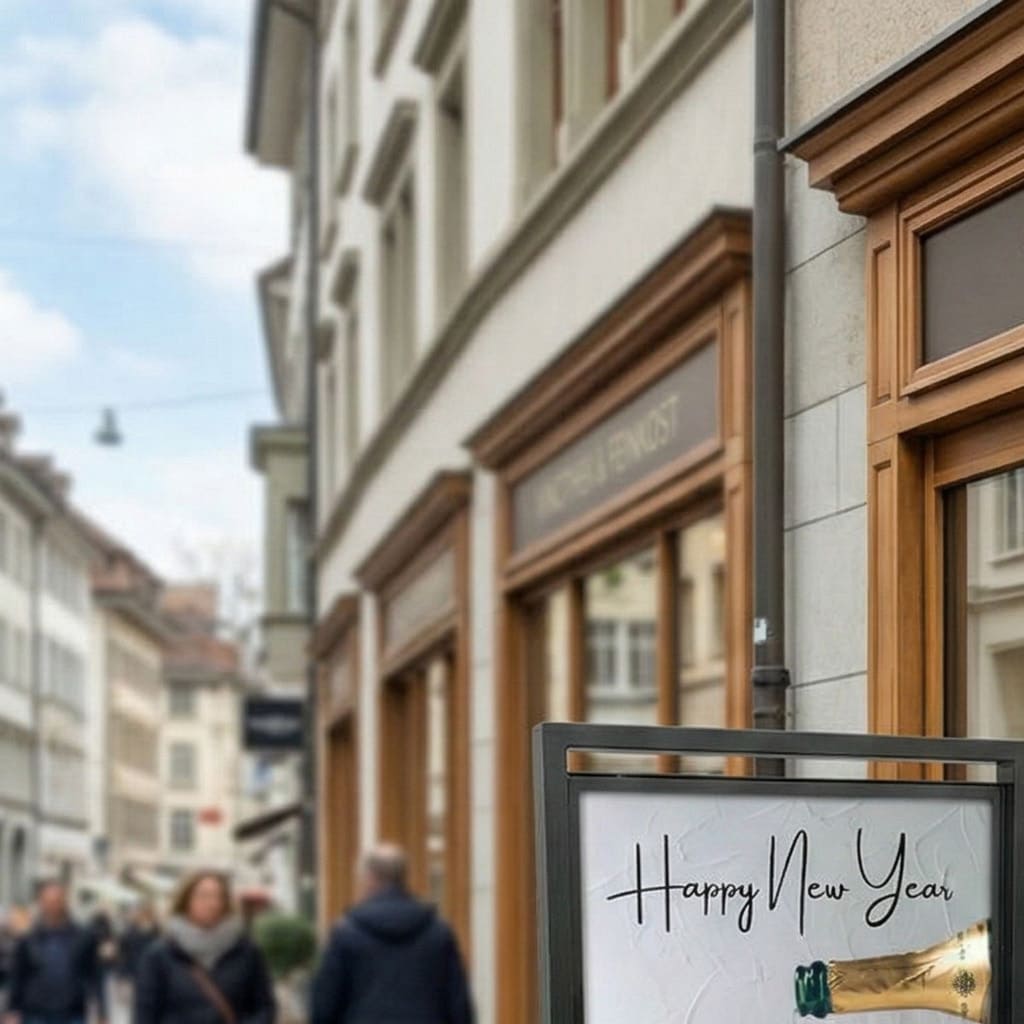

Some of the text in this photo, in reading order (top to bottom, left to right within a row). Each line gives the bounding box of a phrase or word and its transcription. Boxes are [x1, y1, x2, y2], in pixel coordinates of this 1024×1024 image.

[606, 827, 954, 937] Happy New Year
